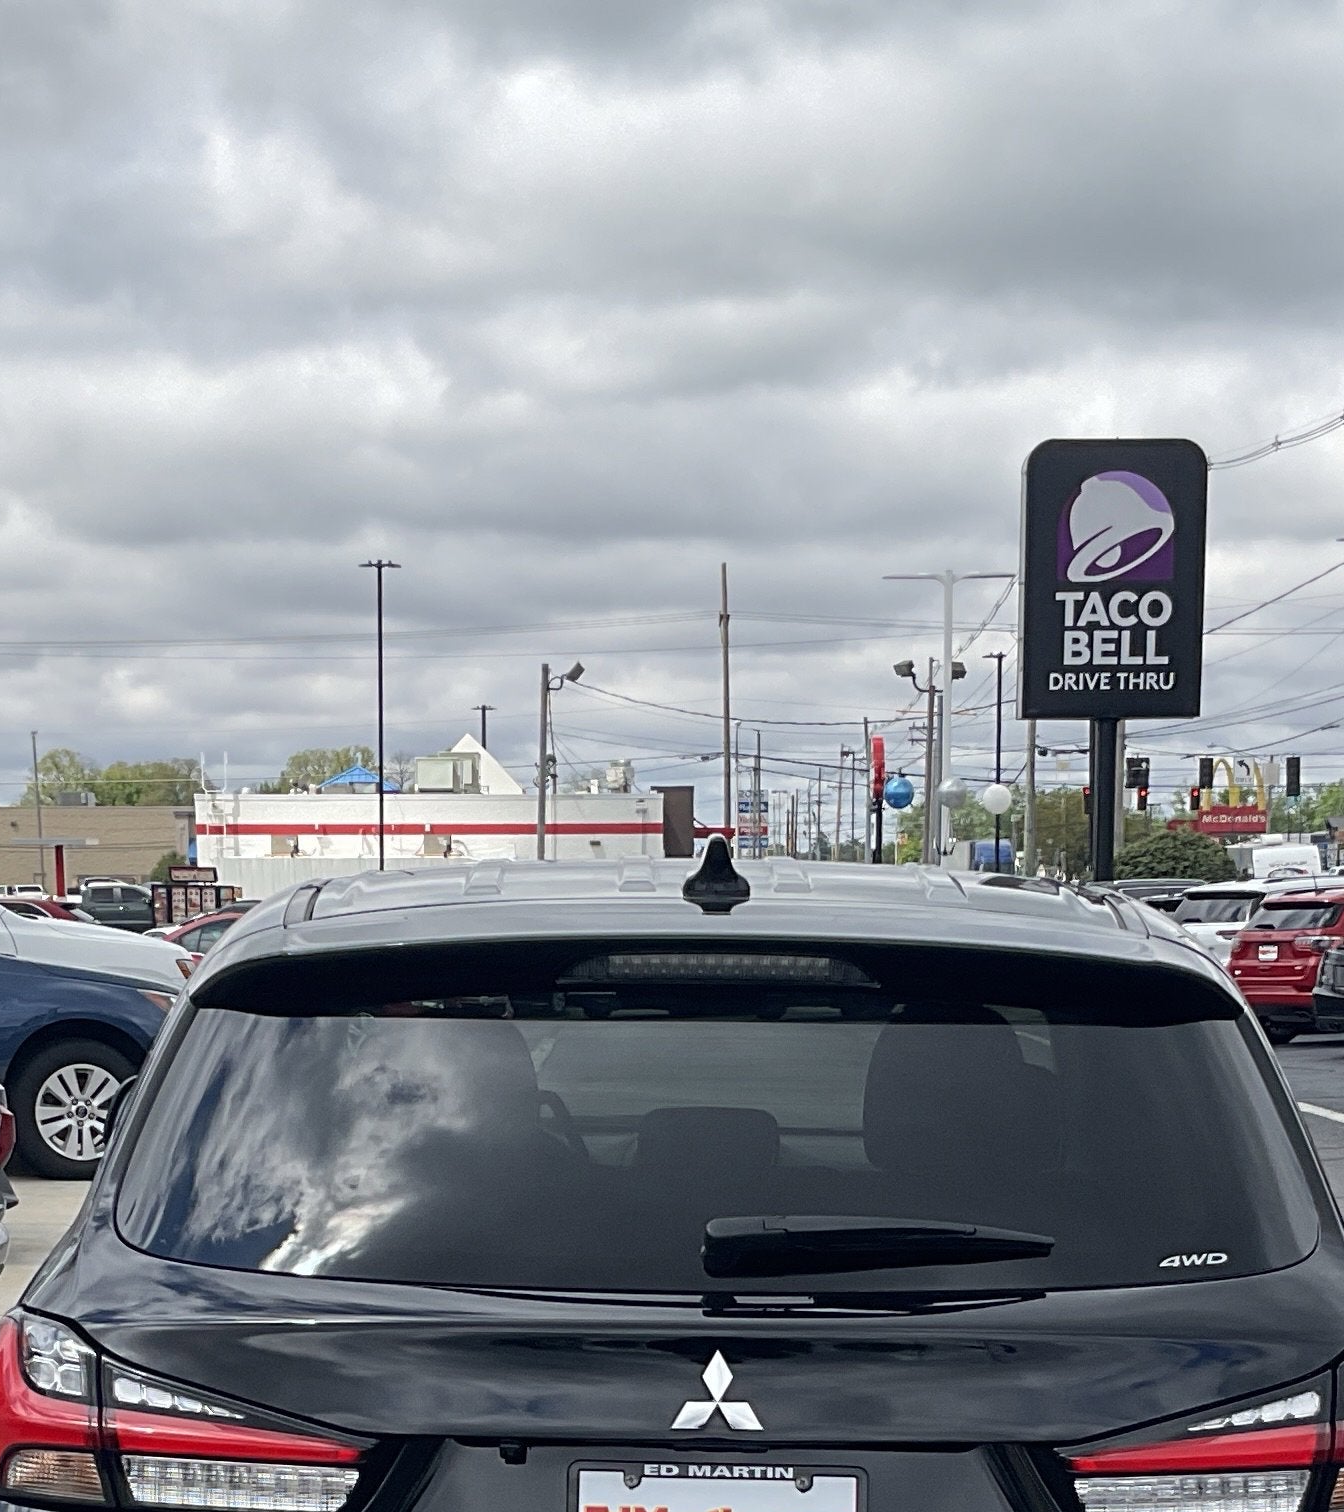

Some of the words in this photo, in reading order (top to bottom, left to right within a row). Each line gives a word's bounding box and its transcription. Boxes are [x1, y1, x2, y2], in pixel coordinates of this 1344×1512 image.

[1055, 590, 1173, 627] TACO
[1063, 629, 1169, 666] BELL
[1048, 672, 1111, 691] DRIVE
[1116, 671, 1176, 691] THRU
[1159, 1252, 1228, 1268] 4WD
[643, 1463, 679, 1477] ED
[688, 1464, 795, 1479] MARTIN
